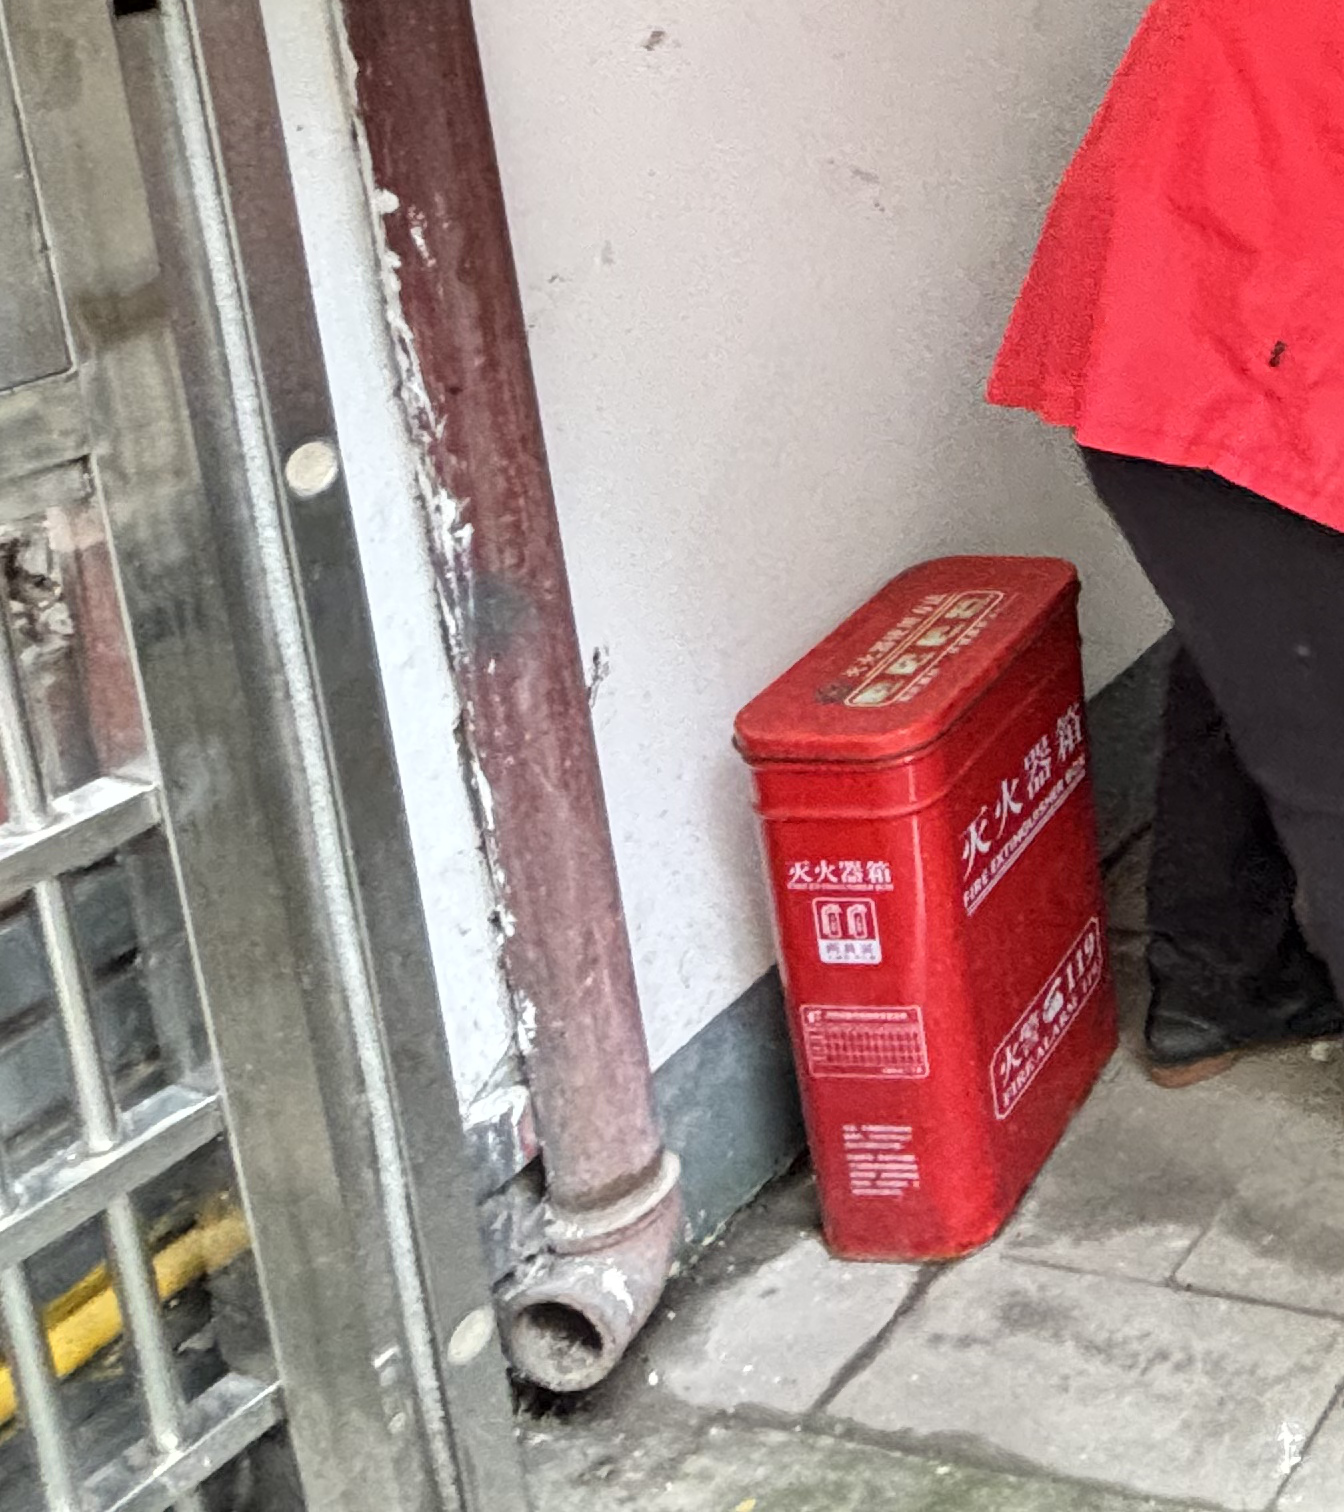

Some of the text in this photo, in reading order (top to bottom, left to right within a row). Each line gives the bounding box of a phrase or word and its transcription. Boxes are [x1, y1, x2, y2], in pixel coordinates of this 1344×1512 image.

[958, 702, 1083, 882] 灭火器箱
[785, 859, 893, 884] 灭火器箱
